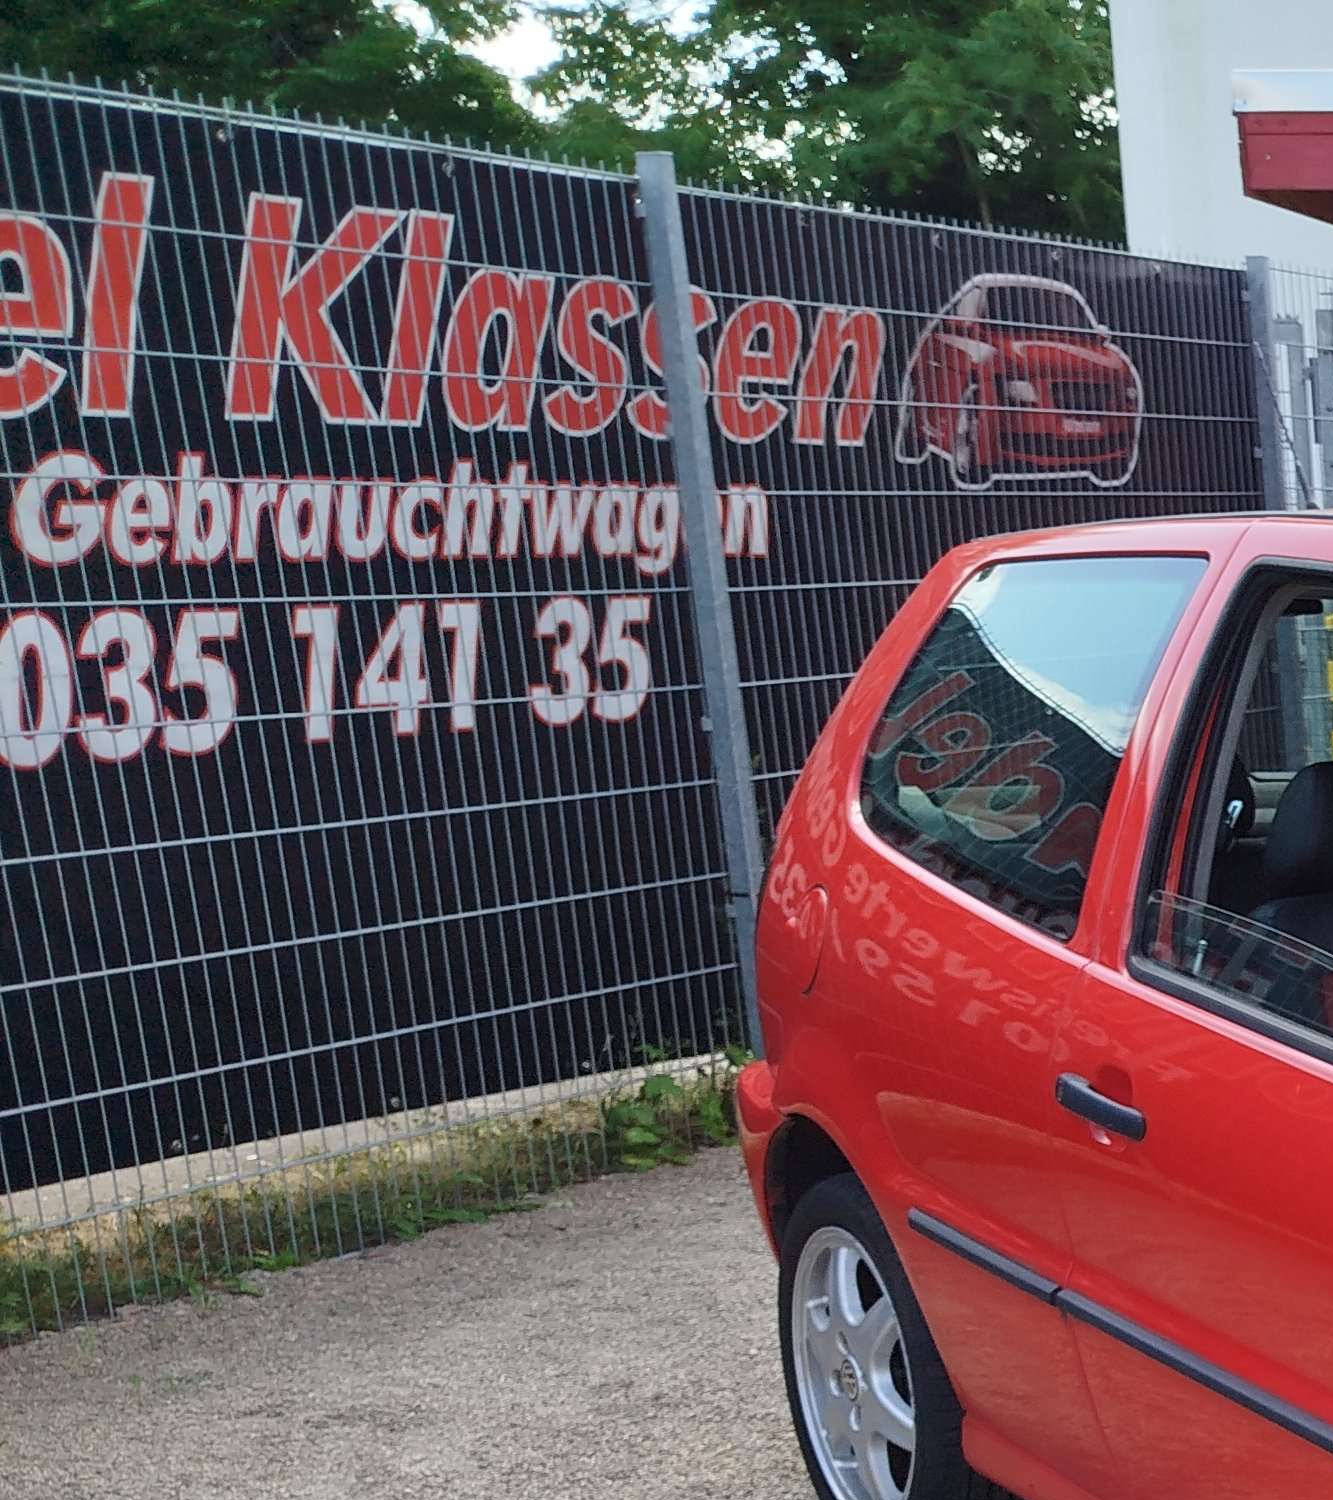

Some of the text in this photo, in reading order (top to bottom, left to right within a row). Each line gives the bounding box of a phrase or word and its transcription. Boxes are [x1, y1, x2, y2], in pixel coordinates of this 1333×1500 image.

[9, 449, 769, 576] Gebrauchtwagn
[0, 596, 652, 771] 035 141 35
